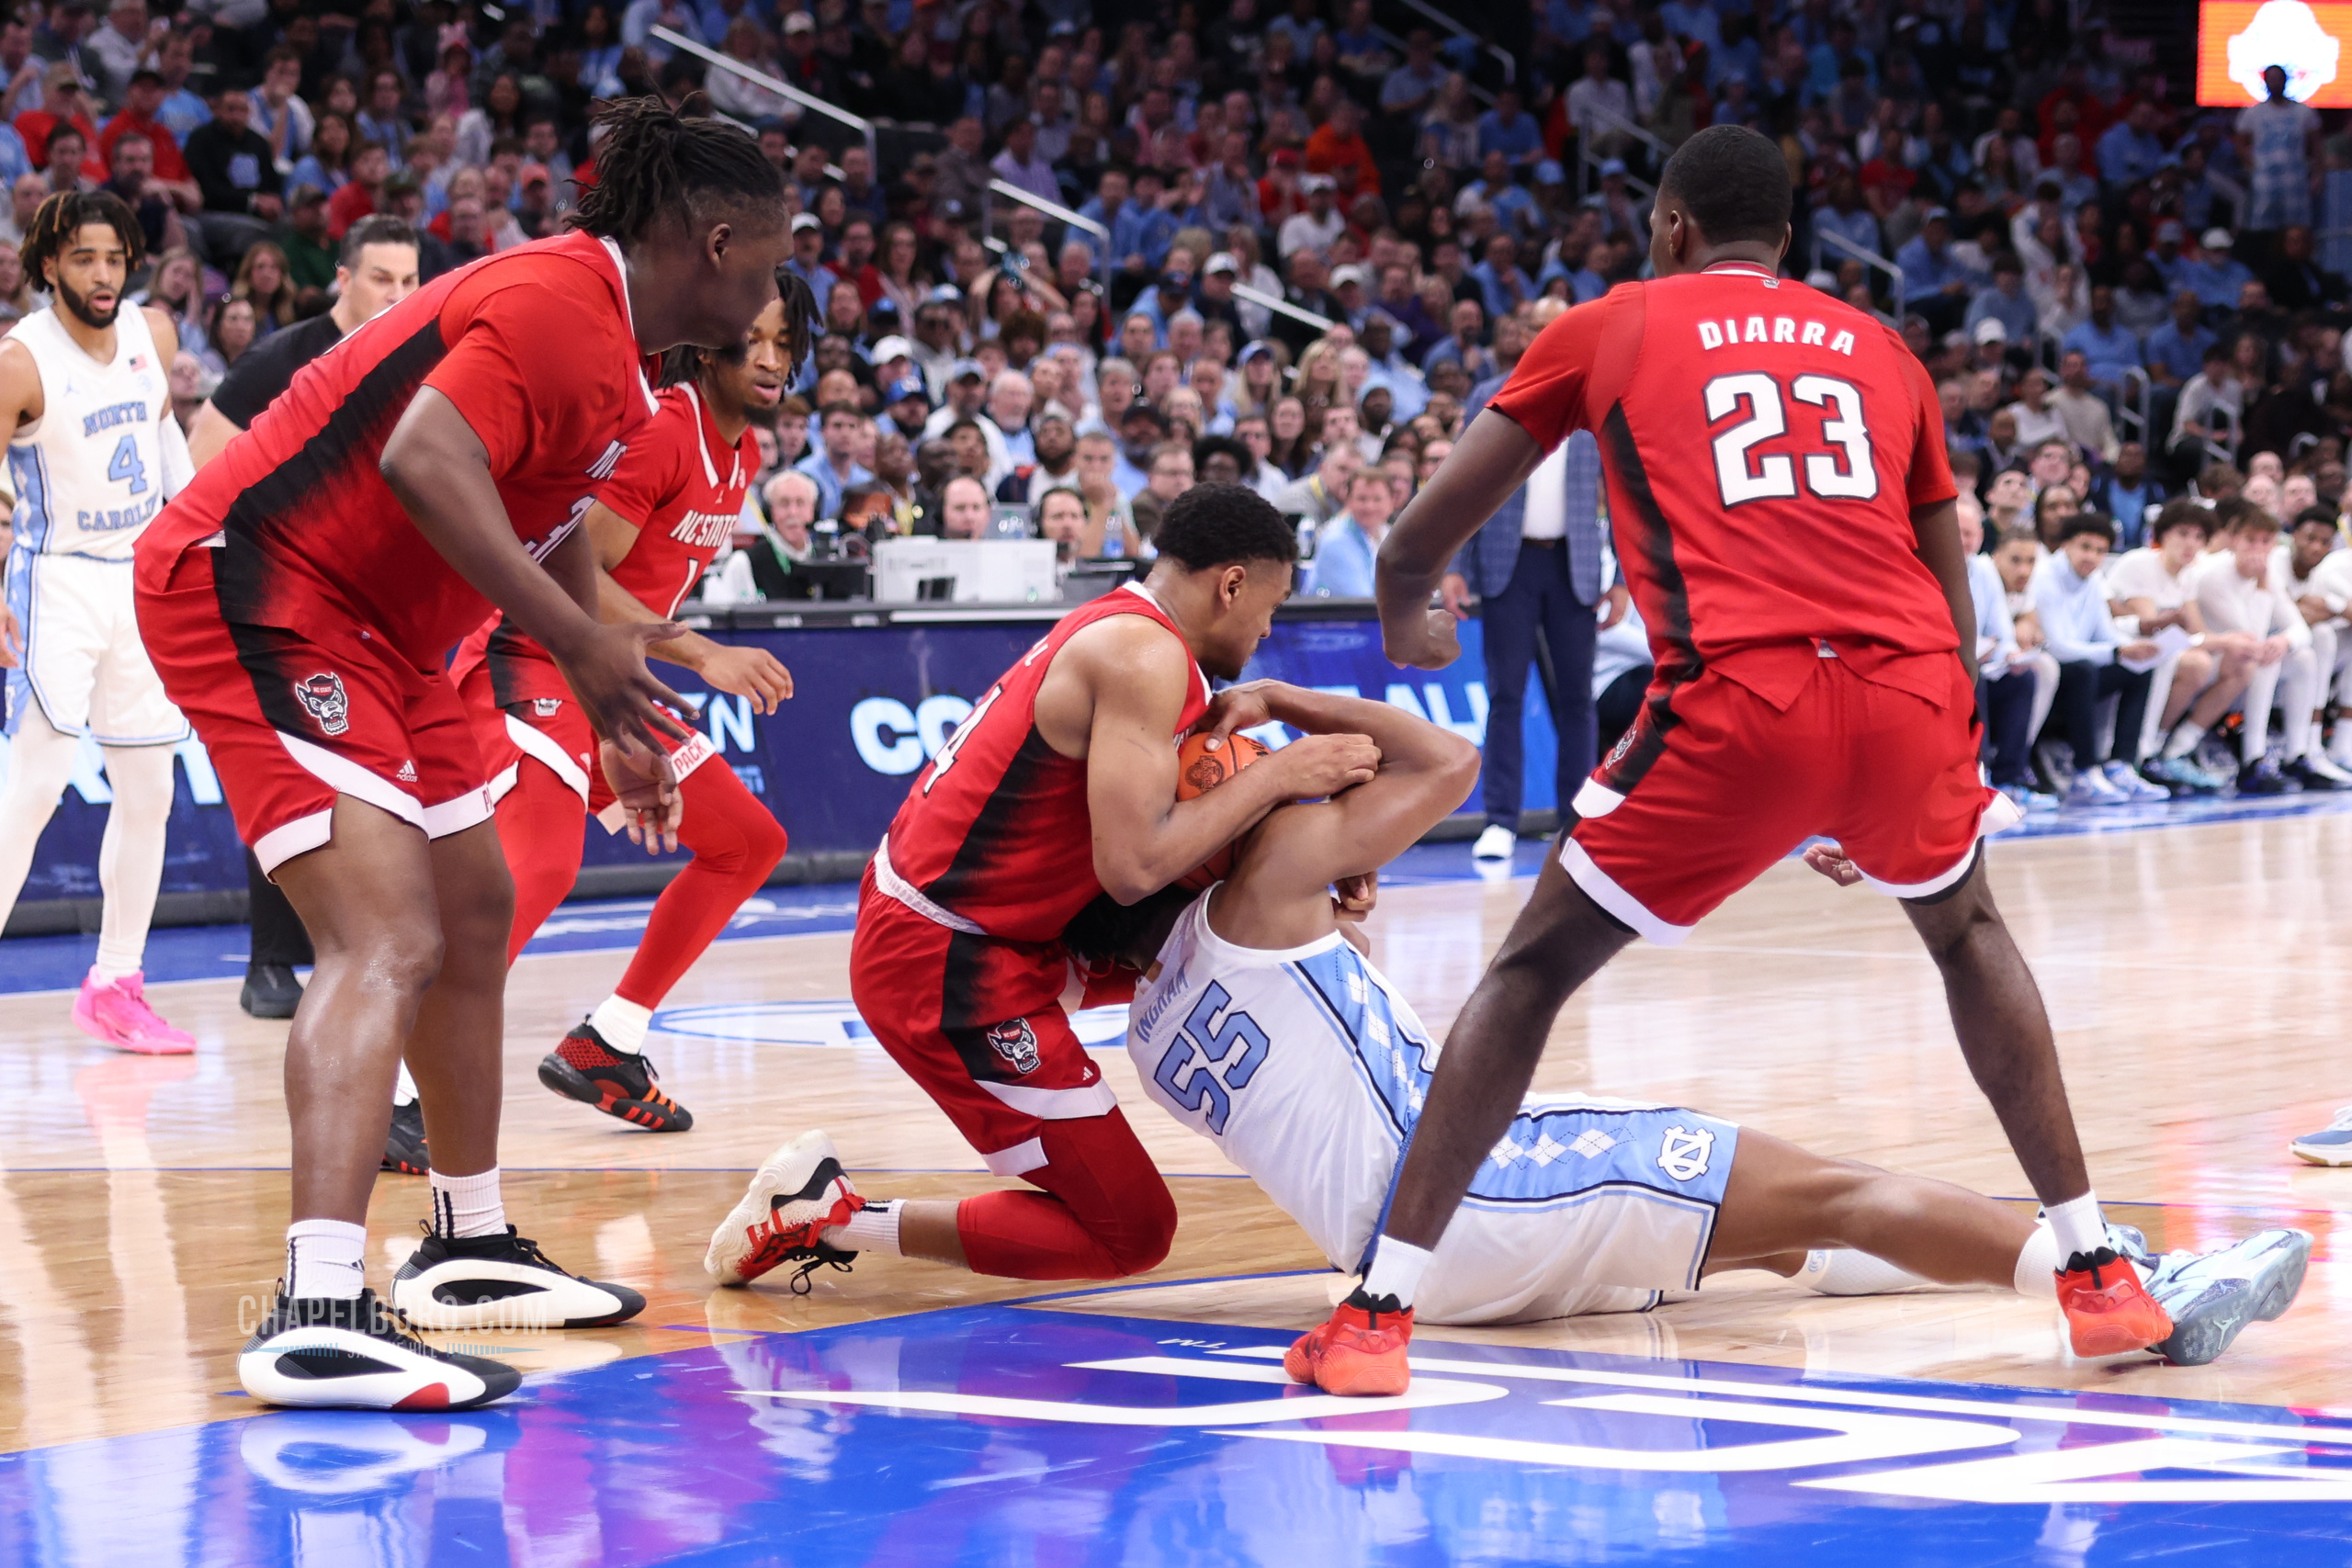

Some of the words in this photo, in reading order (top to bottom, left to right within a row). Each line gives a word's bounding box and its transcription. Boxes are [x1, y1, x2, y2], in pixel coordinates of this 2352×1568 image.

[1698, 316, 1855, 356] DIARRA
[83, 401, 148, 437] NORTH
[1702, 370, 1881, 512] 23
[107, 434, 148, 495] 4
[666, 557, 700, 621] 1
[673, 739, 707, 775] PACK
[1136, 958, 1189, 1043] INGRAM
[1154, 979, 1271, 1136] 55
